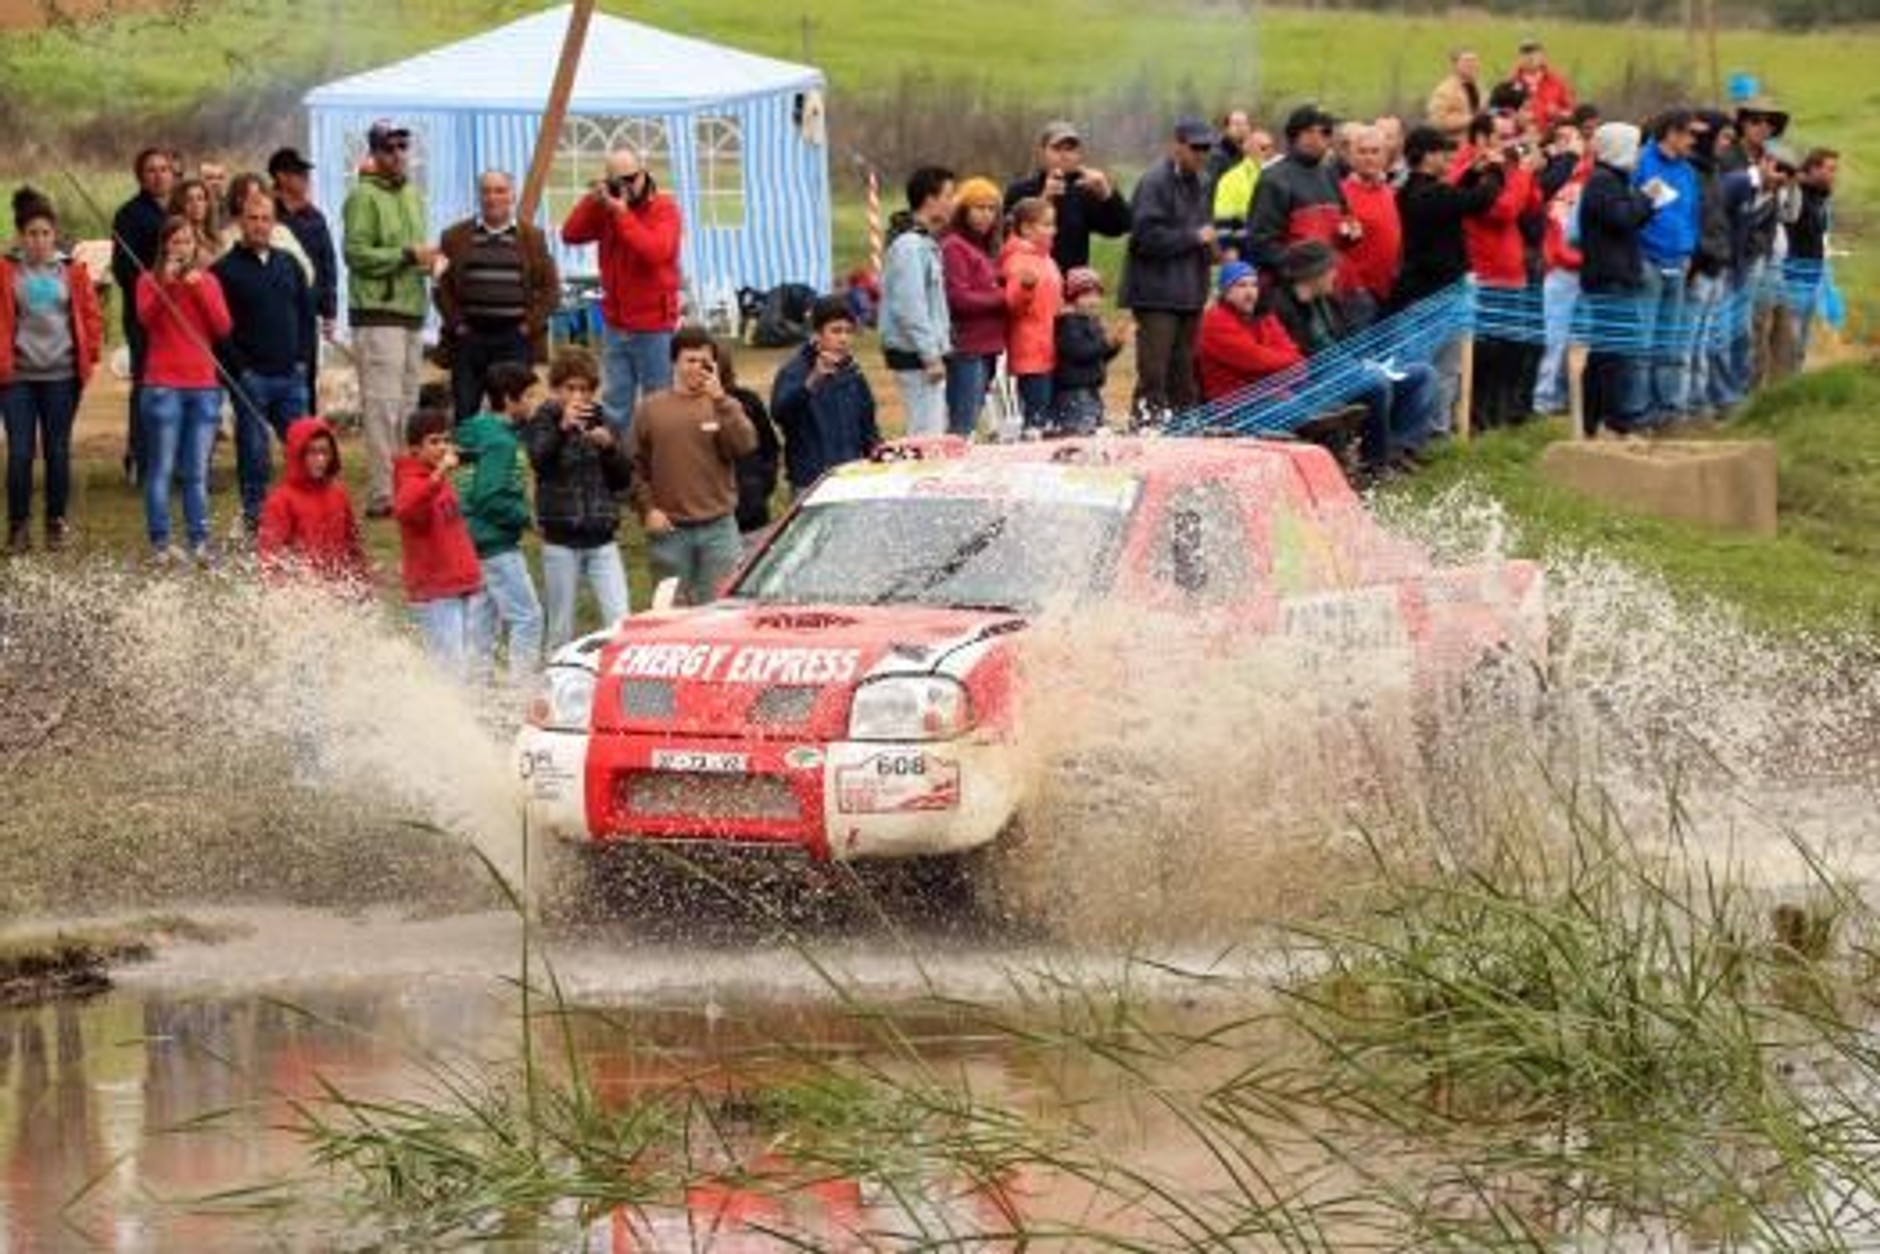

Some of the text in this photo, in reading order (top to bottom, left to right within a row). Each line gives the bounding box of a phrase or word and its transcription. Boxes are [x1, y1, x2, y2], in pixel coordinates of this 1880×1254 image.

[611, 643, 860, 683] ENERGY EXPRESS
[877, 755, 926, 776] 608
